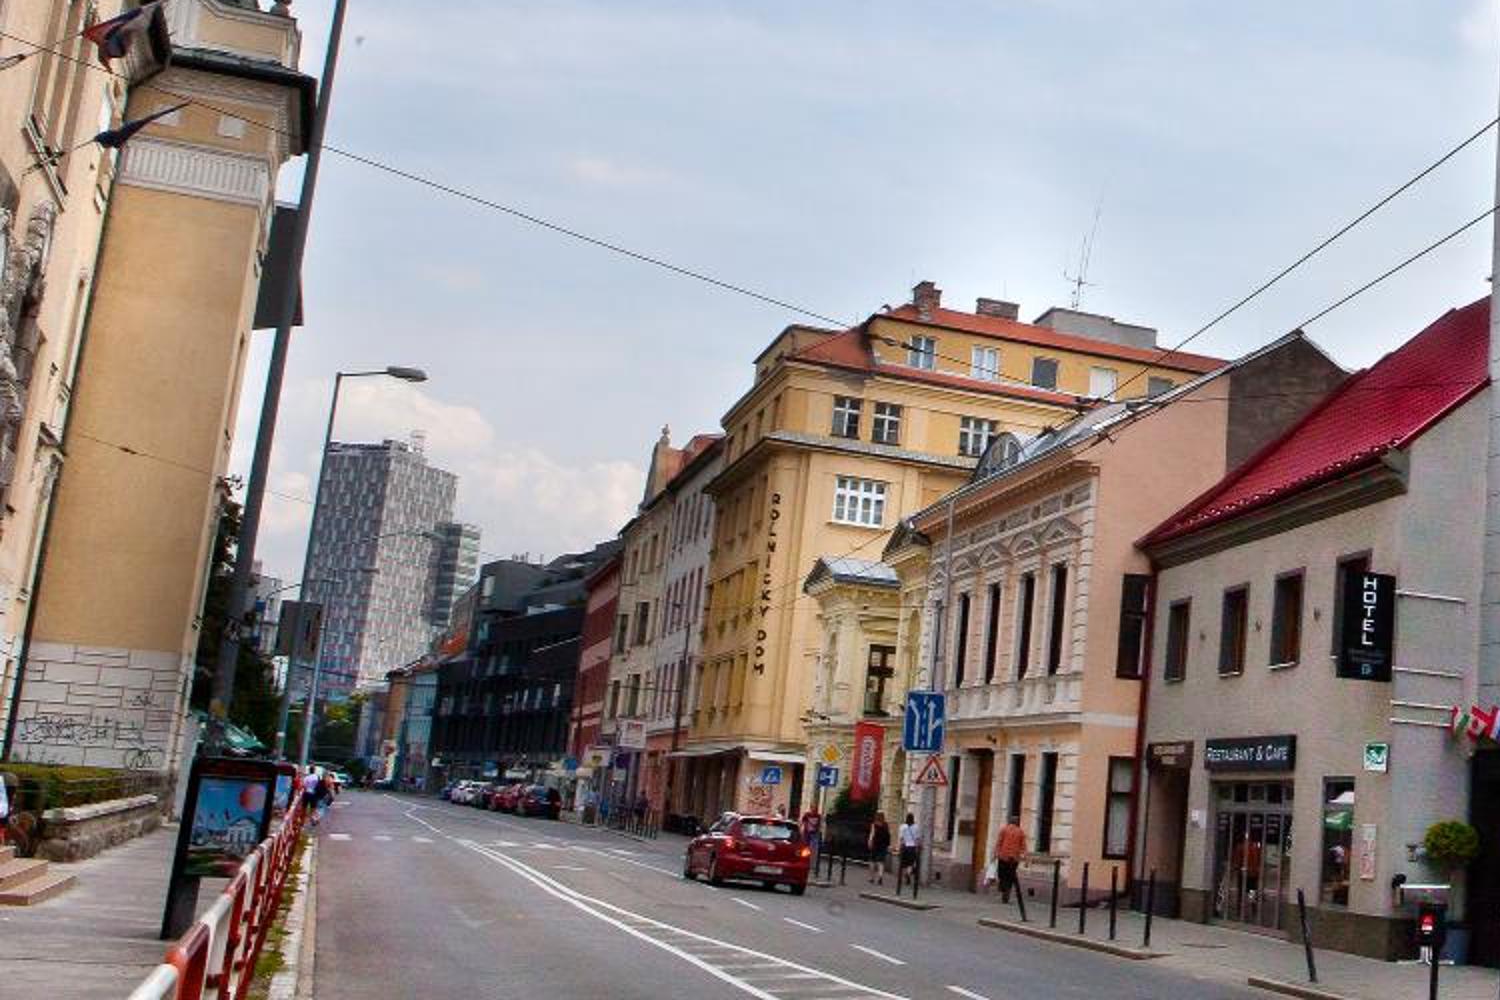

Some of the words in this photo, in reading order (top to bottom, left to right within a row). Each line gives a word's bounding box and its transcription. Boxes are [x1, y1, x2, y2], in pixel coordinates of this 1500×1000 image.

[1362, 577, 1377, 645] HOTEL
[753, 629, 767, 675] DOM
[1207, 747, 1254, 762] RESTAURANT
[1255, 745, 1263, 761] &
